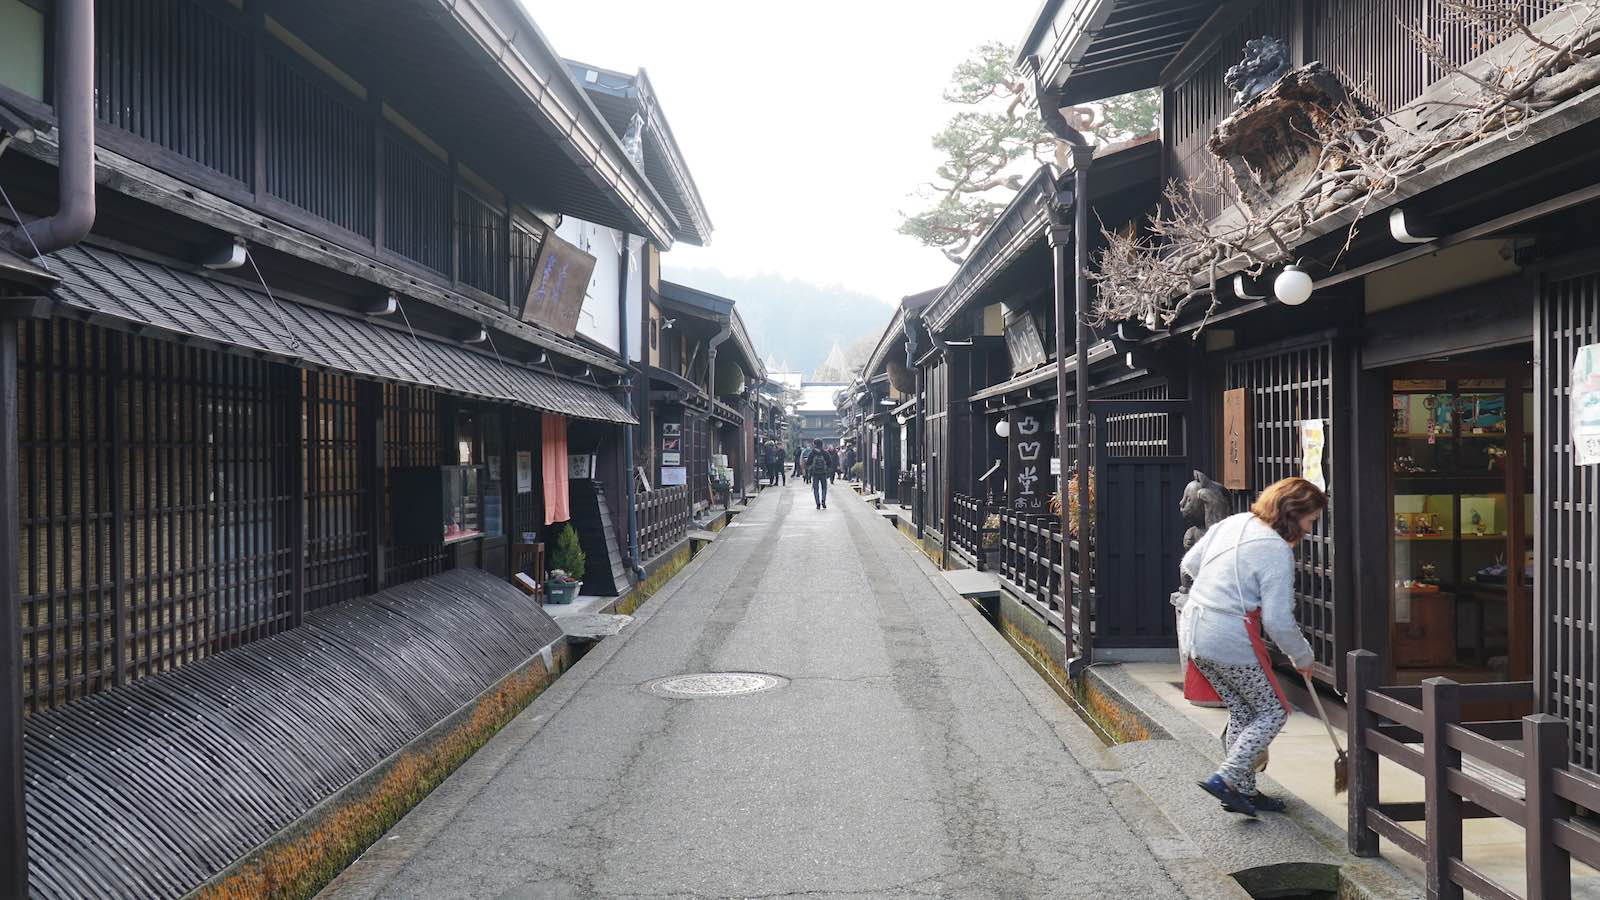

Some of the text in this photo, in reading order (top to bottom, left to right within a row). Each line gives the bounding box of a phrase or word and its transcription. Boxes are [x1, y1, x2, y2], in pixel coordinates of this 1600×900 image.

[1017, 416, 1040, 495] 凸凹堂
[1014, 497, 1041, 509] 高山
